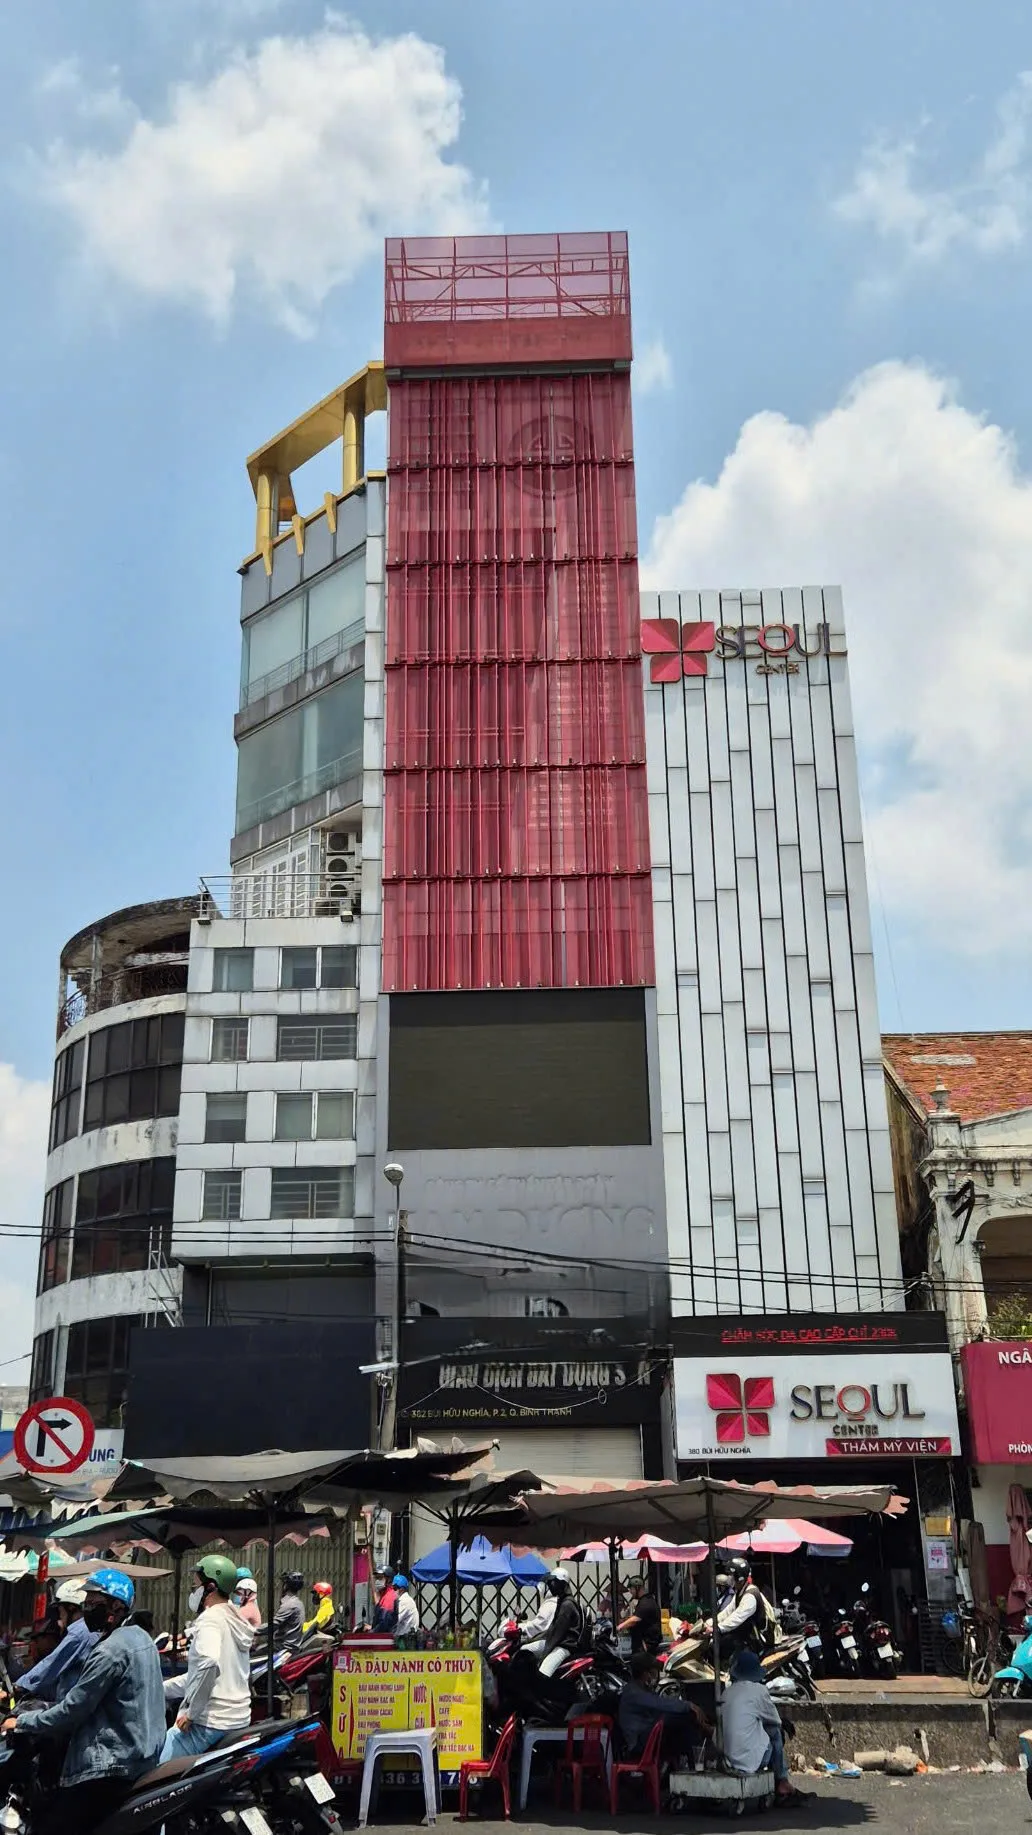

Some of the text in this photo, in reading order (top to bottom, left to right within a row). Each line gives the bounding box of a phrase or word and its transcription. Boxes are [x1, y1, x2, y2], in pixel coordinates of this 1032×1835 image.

[715, 622, 848, 660] SEOUL
[755, 663, 801, 675] CENTER
[790, 1384, 926, 1422] SEOUL
[832, 1424, 879, 1437] CENTER
[883, 1440, 903, 1453] MỸ
[906, 1439, 938, 1454] VIỆN
[365, 1657, 389, 1677] ĐẬU
[392, 1657, 424, 1673] NÀNH
[427, 1656, 441, 1673] CÔ
[445, 1655, 475, 1673] THỦY
